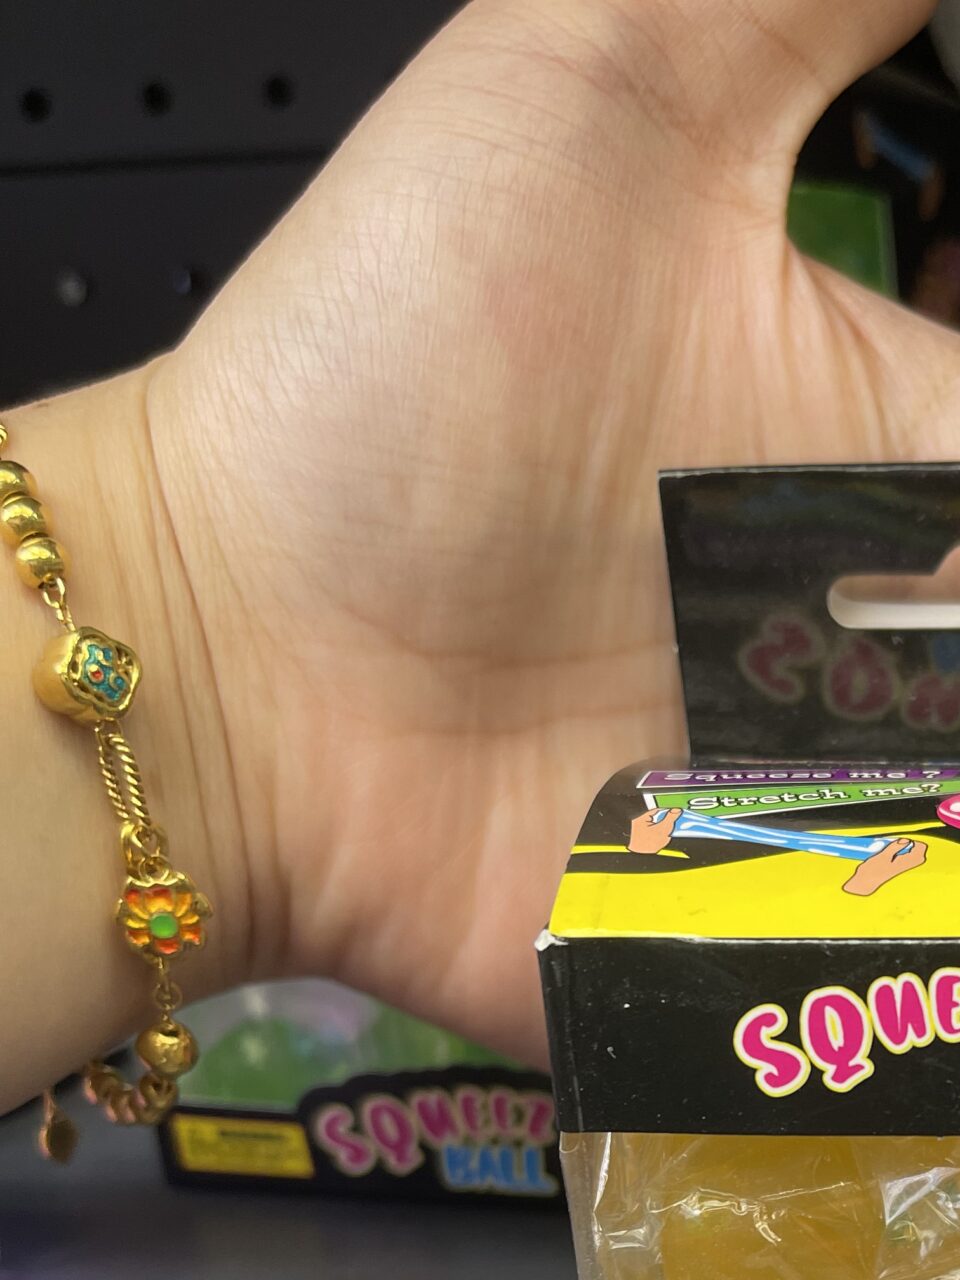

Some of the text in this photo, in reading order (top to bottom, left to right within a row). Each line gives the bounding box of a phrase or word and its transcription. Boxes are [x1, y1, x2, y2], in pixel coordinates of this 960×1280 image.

[664, 772, 831, 782] Squeeze
[849, 772, 906, 781] me
[688, 783, 942, 812] Stretch me?
[313, 1085, 557, 1177] SQUEEZ
